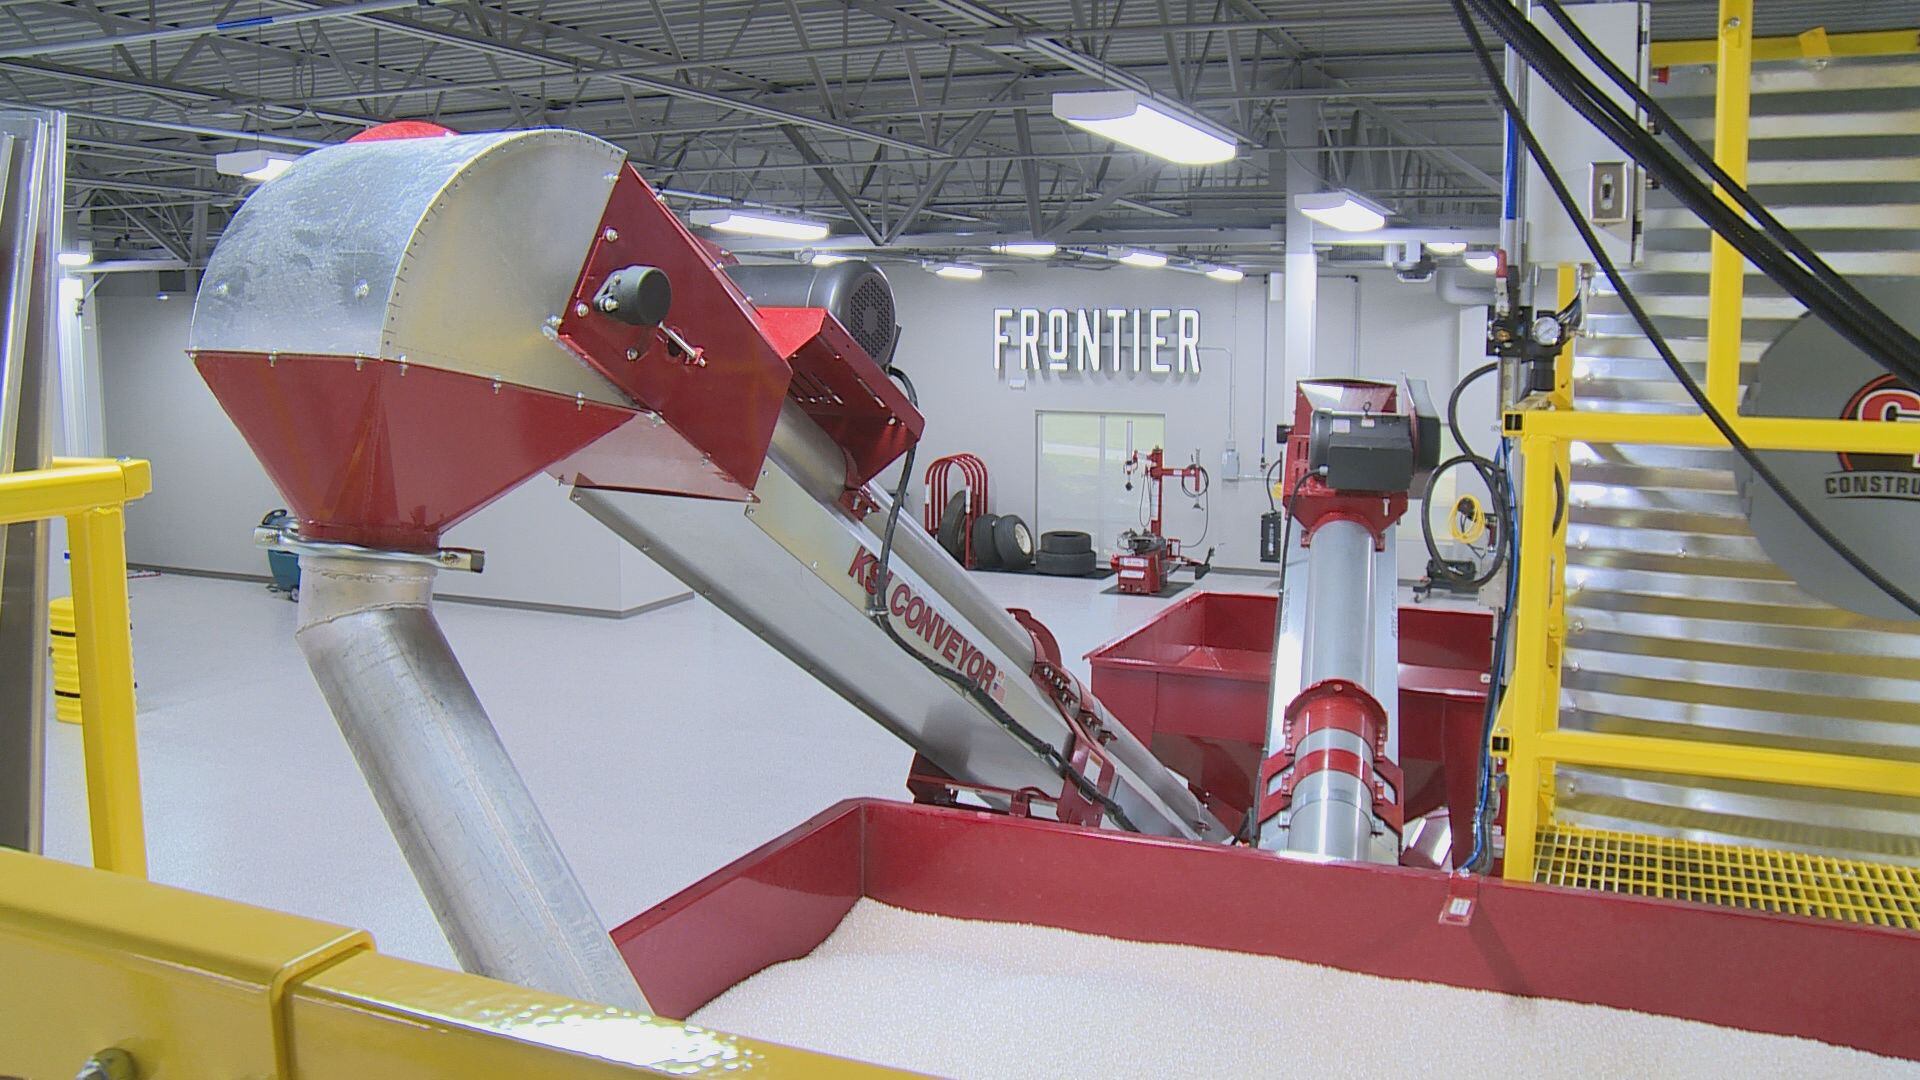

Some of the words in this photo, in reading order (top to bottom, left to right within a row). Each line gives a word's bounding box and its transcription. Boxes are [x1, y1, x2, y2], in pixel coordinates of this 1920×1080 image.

[993, 308, 1201, 373] FRONTIER
[1825, 476, 1920, 495] CONSTRU
[890, 583, 997, 693] CONVEYOR
